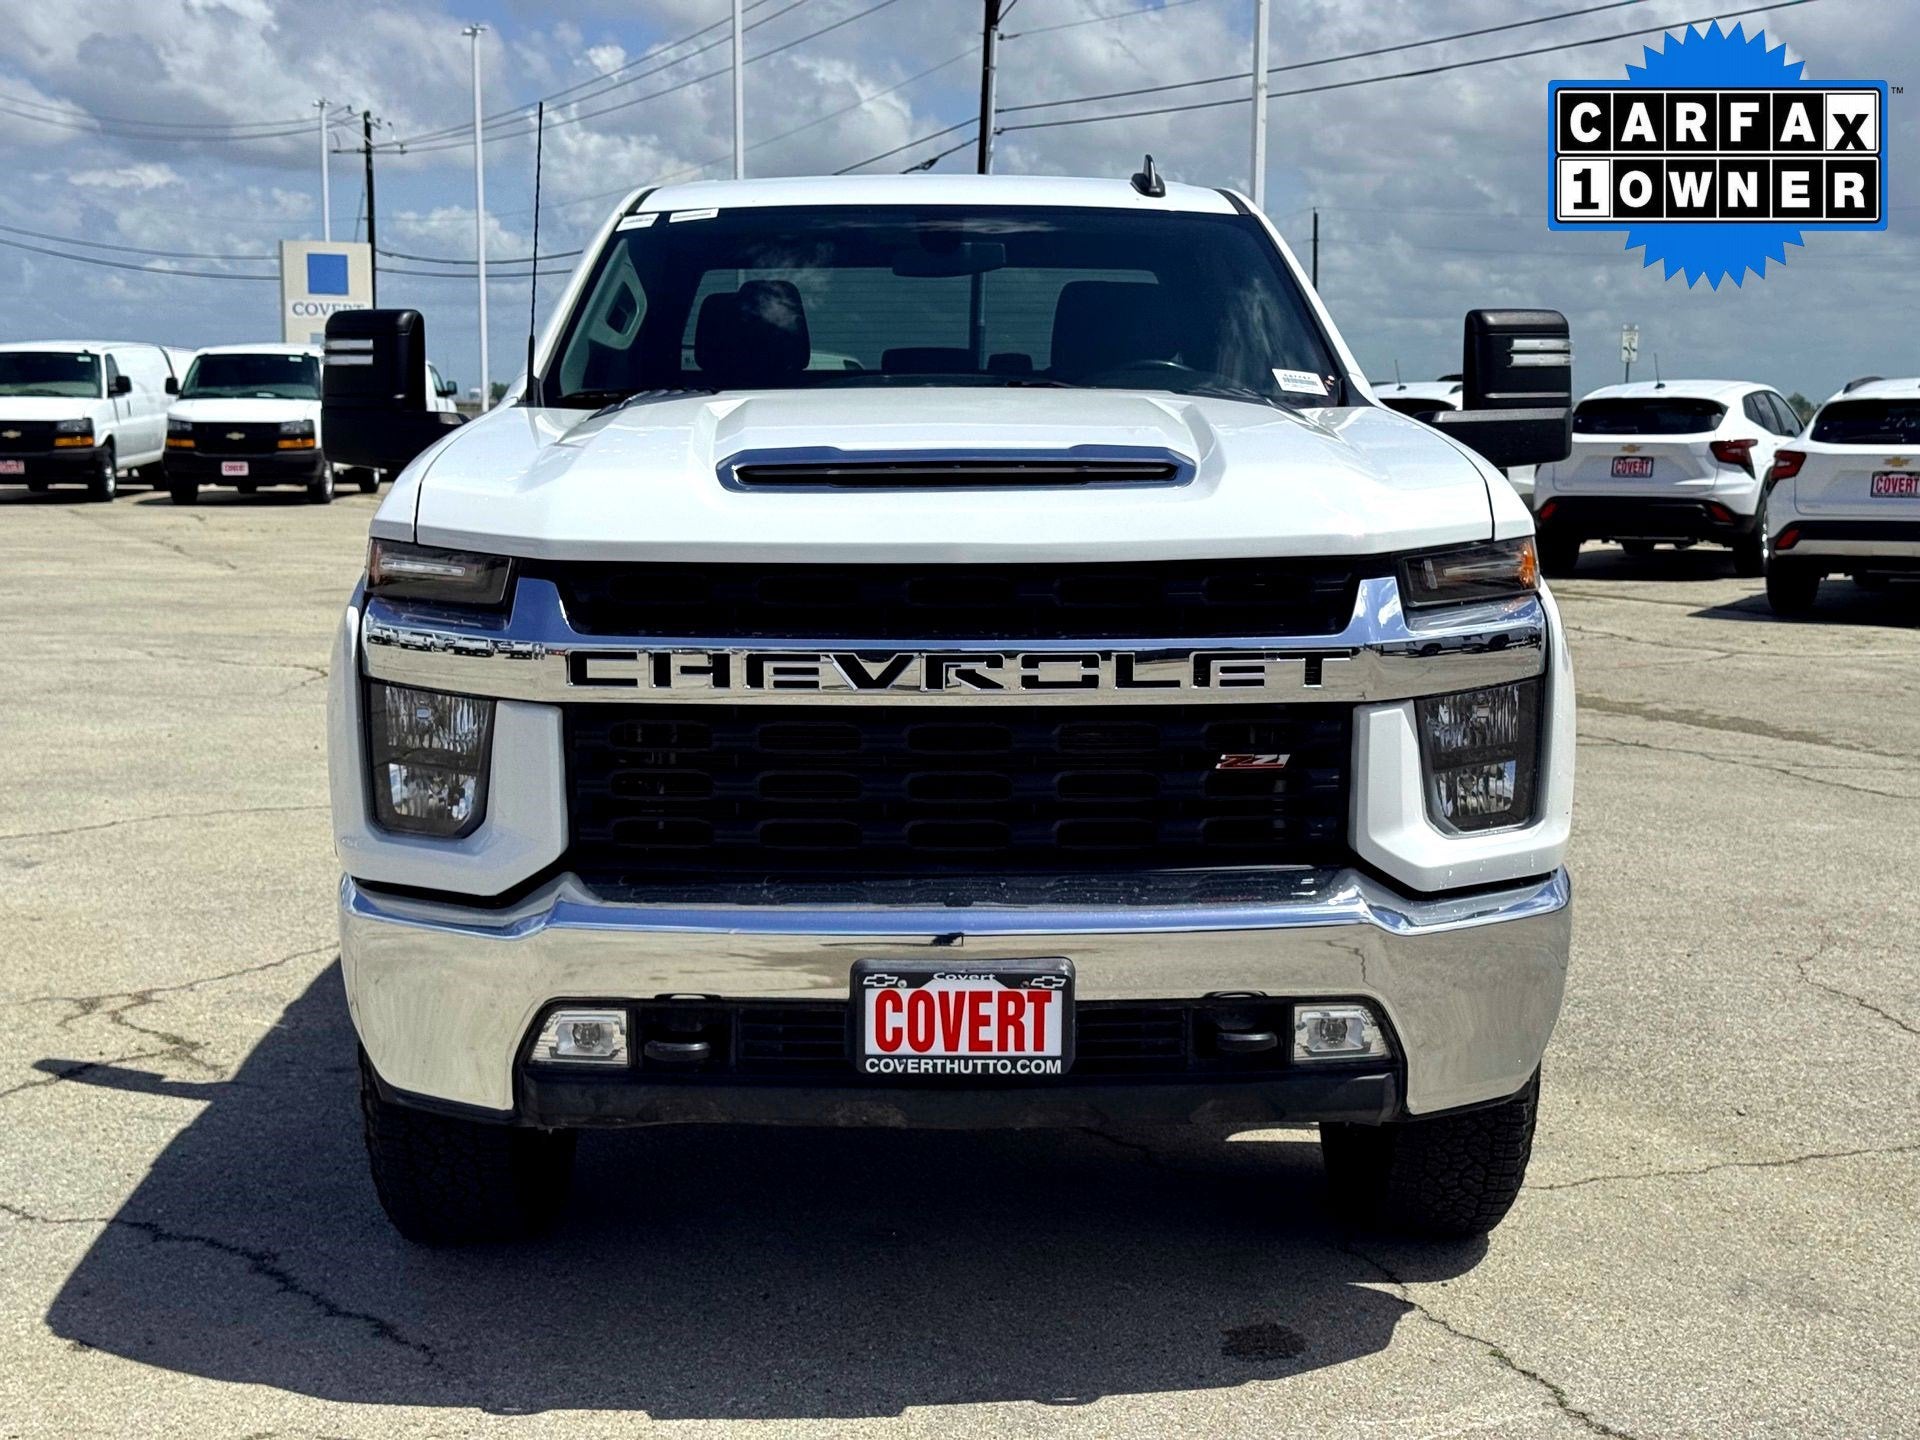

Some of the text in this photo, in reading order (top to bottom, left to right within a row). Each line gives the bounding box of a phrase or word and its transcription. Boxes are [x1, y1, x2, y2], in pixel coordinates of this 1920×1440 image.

[1615, 460, 1650, 474] COVERT
[1875, 475, 1920, 494] COVERT
[566, 650, 1352, 692] CHEVROLET
[933, 971, 997, 981] Covert
[875, 988, 1053, 1054] COVERT
[865, 1057, 1062, 1075] COVERTHUTTO.COM
